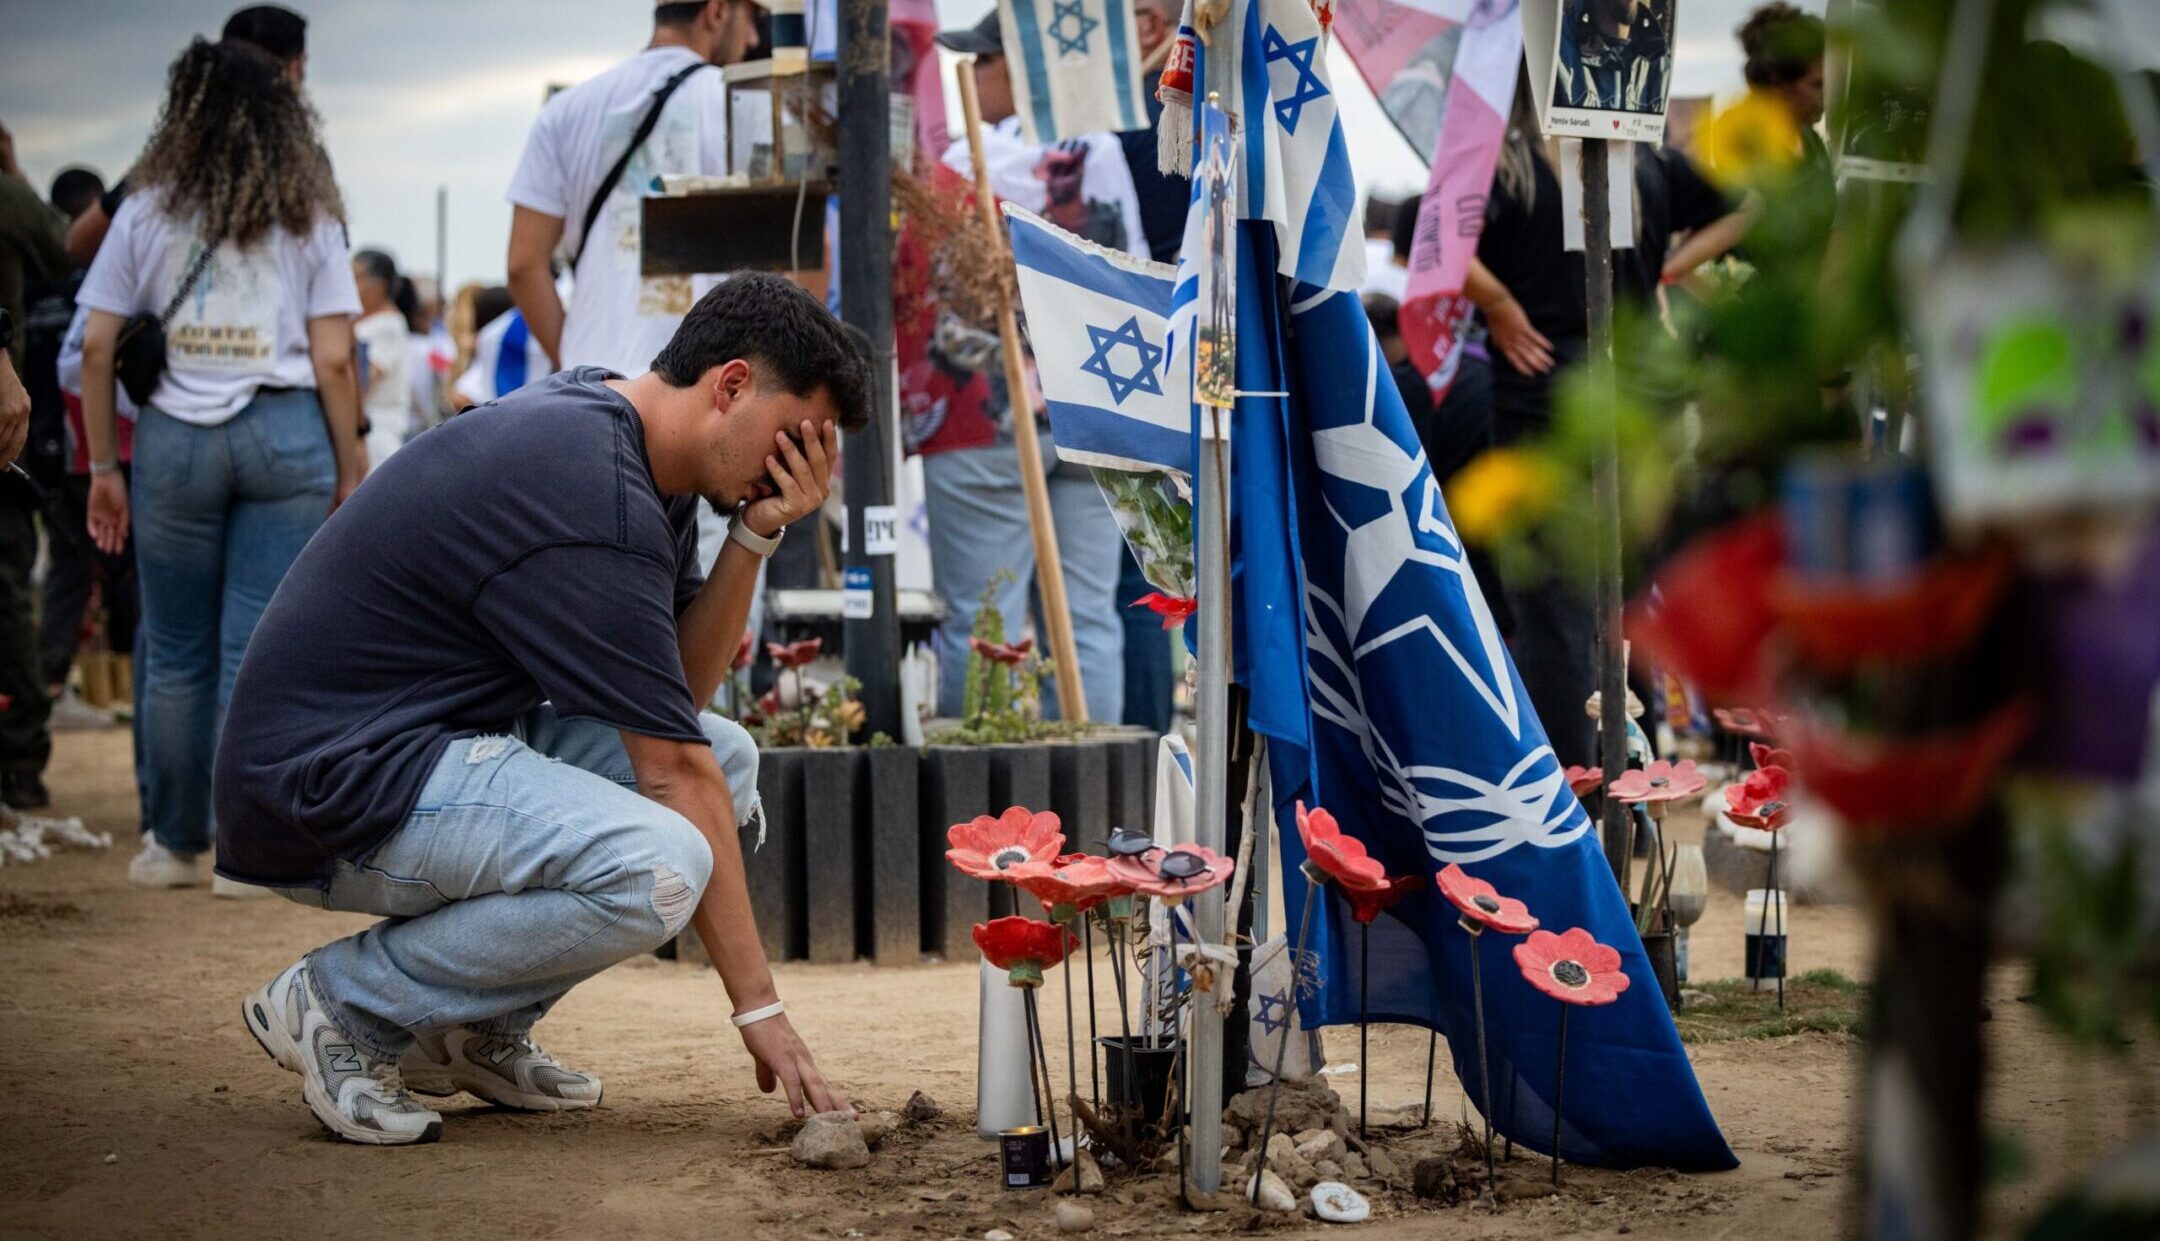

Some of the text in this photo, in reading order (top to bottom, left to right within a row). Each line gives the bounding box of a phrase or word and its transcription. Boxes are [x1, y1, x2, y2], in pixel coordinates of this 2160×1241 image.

[1551, 116, 1568, 125] Yaniv
[325, 1043, 362, 1072] N
[479, 1039, 515, 1065] N
